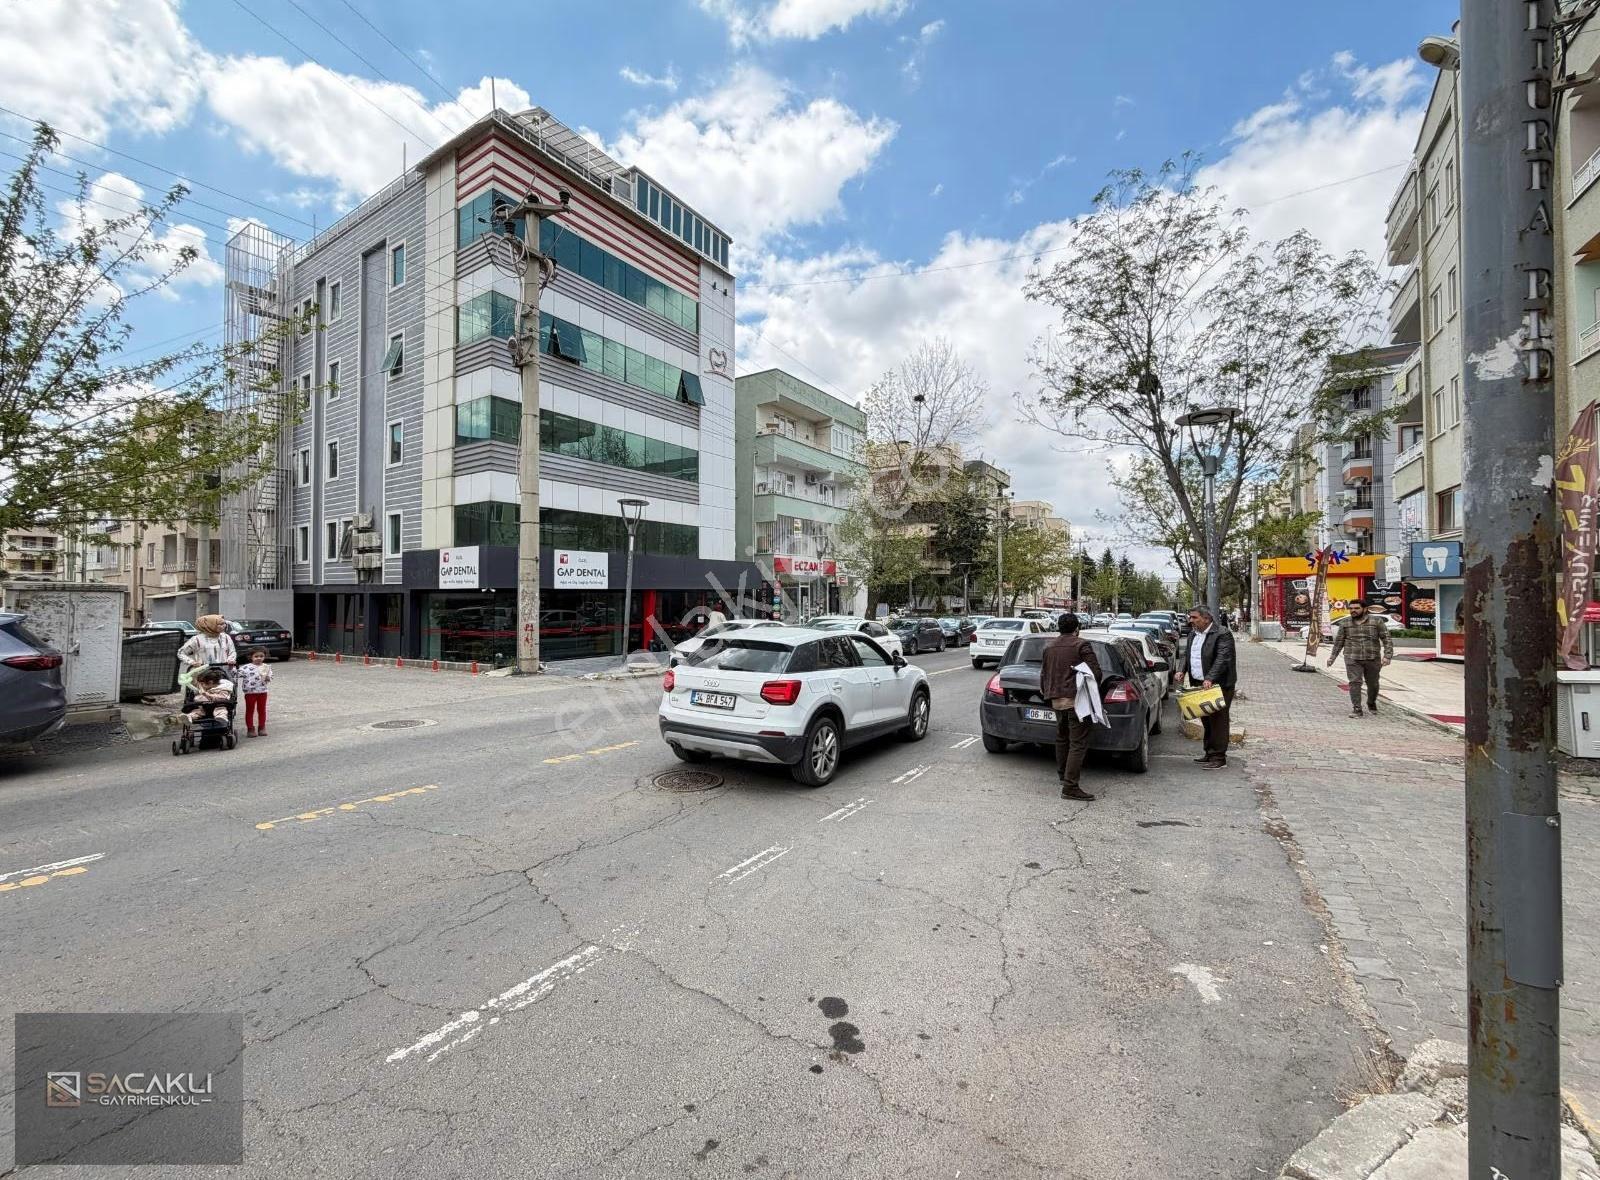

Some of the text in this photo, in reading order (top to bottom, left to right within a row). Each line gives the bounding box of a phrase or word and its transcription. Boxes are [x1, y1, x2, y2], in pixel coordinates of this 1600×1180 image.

[1305, 548, 1350, 570] ŞK
[441, 565, 477, 577] GAP DENTAL
[557, 568, 606, 578] GAP DENTAL
[695, 692, 733, 707] 34 BFA 547
[1030, 710, 1039, 719] 06
